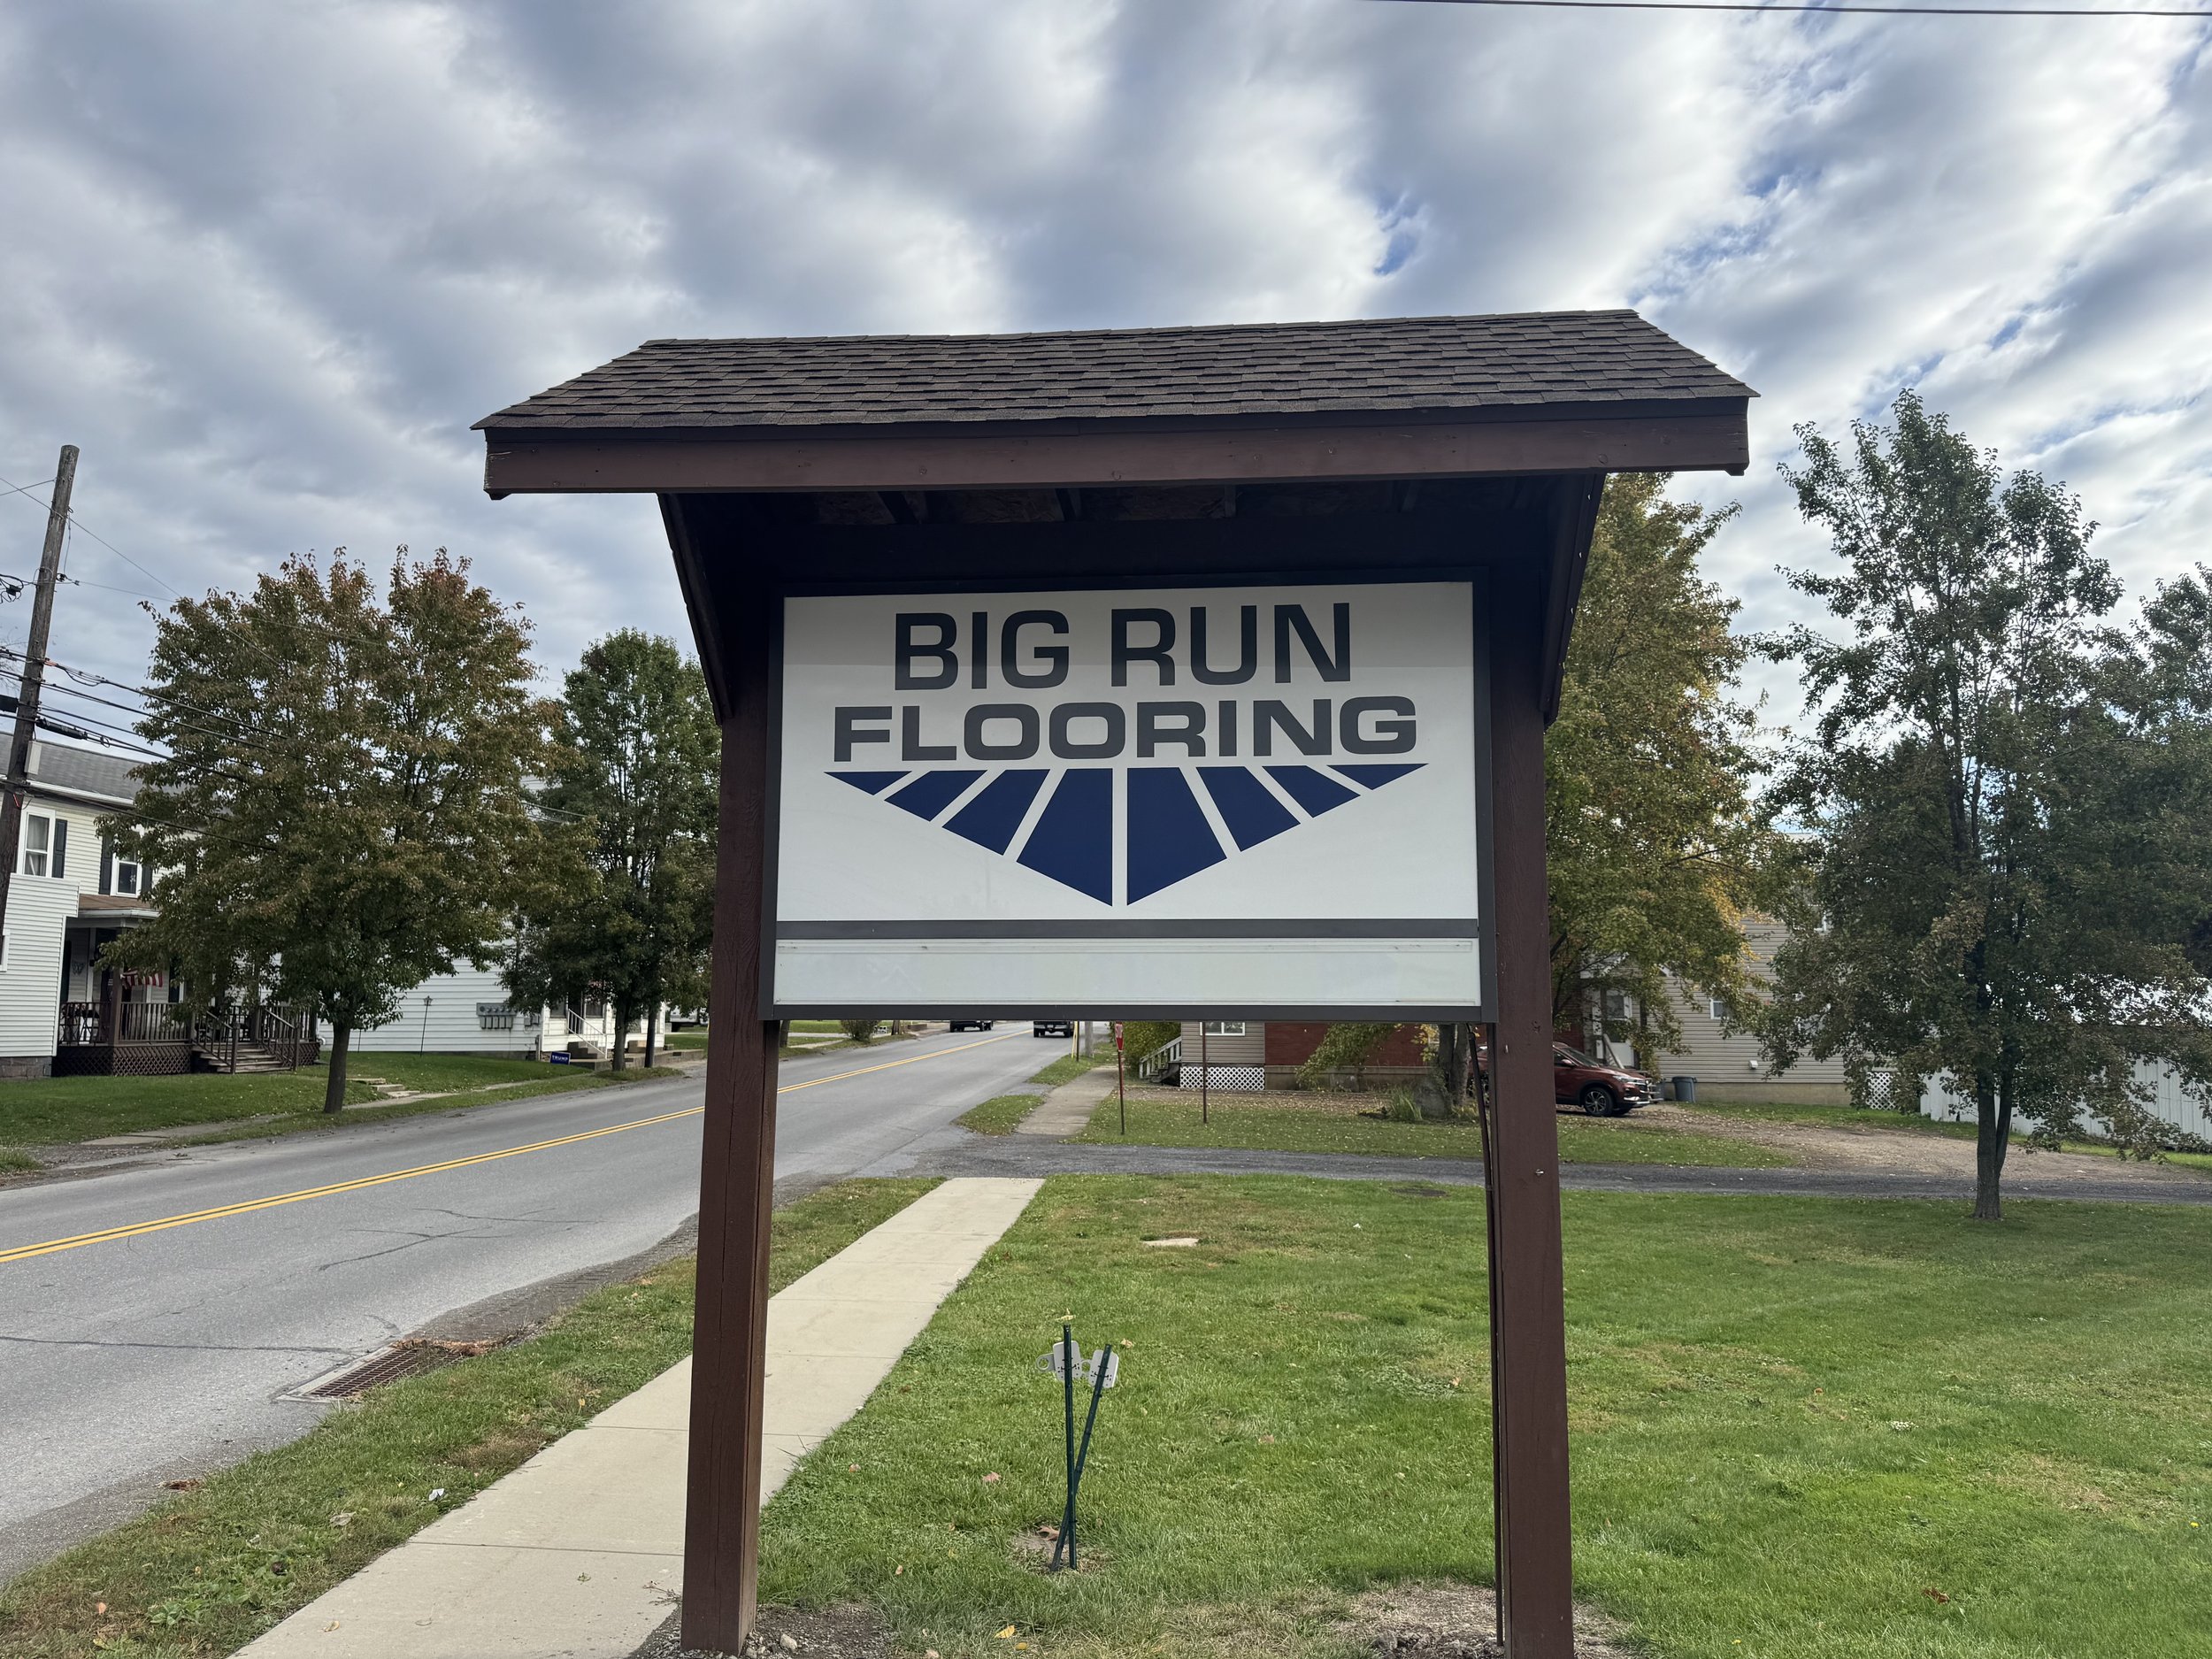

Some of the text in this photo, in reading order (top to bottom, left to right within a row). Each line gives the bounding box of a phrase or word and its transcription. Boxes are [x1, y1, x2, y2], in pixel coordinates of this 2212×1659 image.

[895, 603, 1351, 690] BIG RUN
[834, 696, 1417, 762] FLOORING
